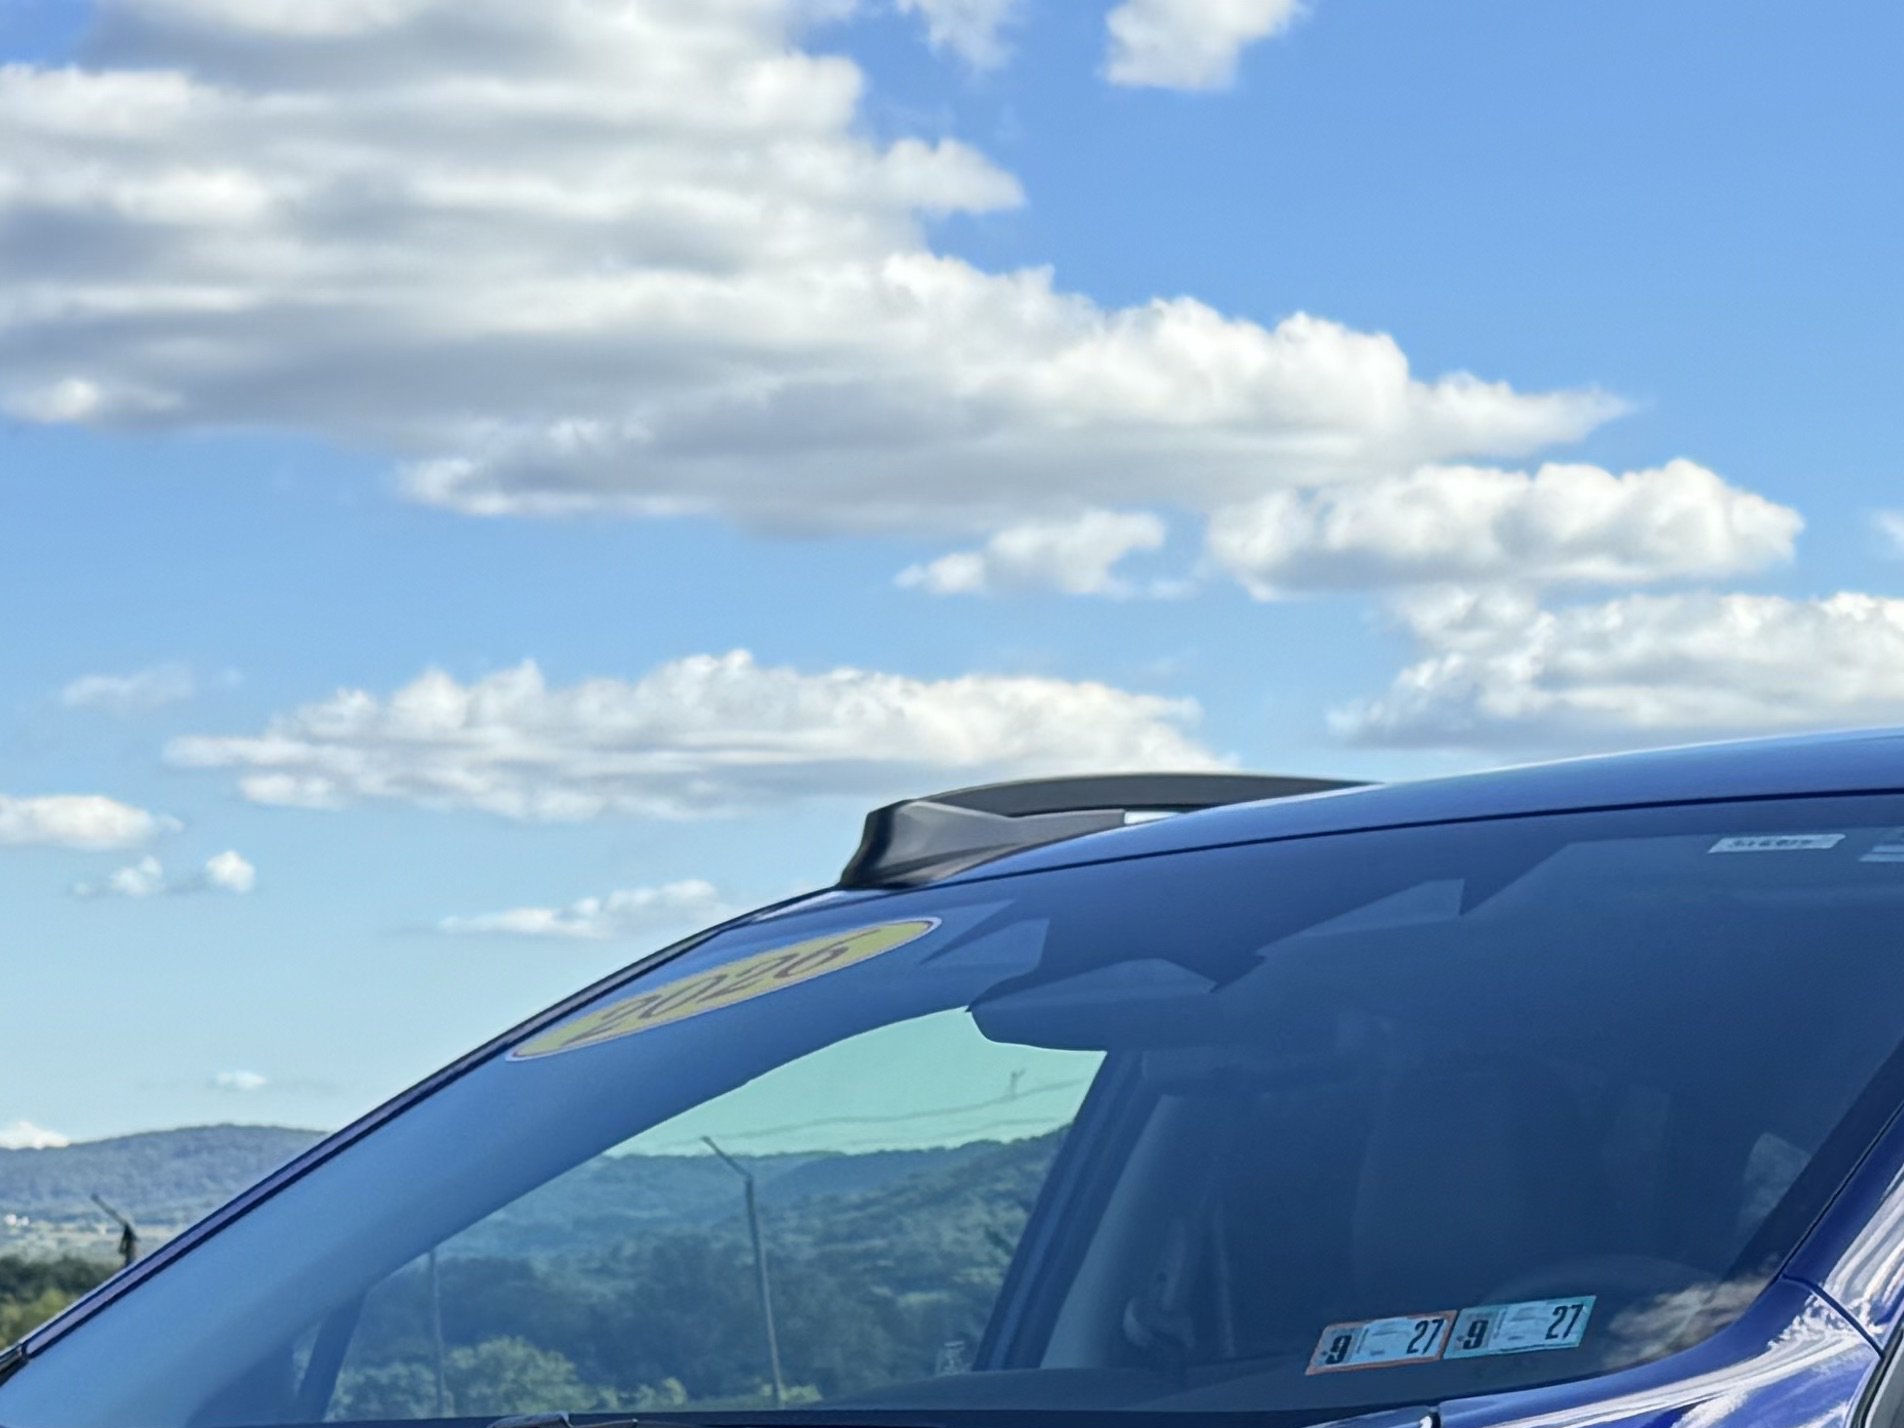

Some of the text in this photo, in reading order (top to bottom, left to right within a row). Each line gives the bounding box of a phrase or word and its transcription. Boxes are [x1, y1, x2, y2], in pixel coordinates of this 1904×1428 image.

[559, 926, 883, 1047] 2026
[1406, 1318, 1446, 1355] 27
[1544, 1303, 1585, 1340] 27
